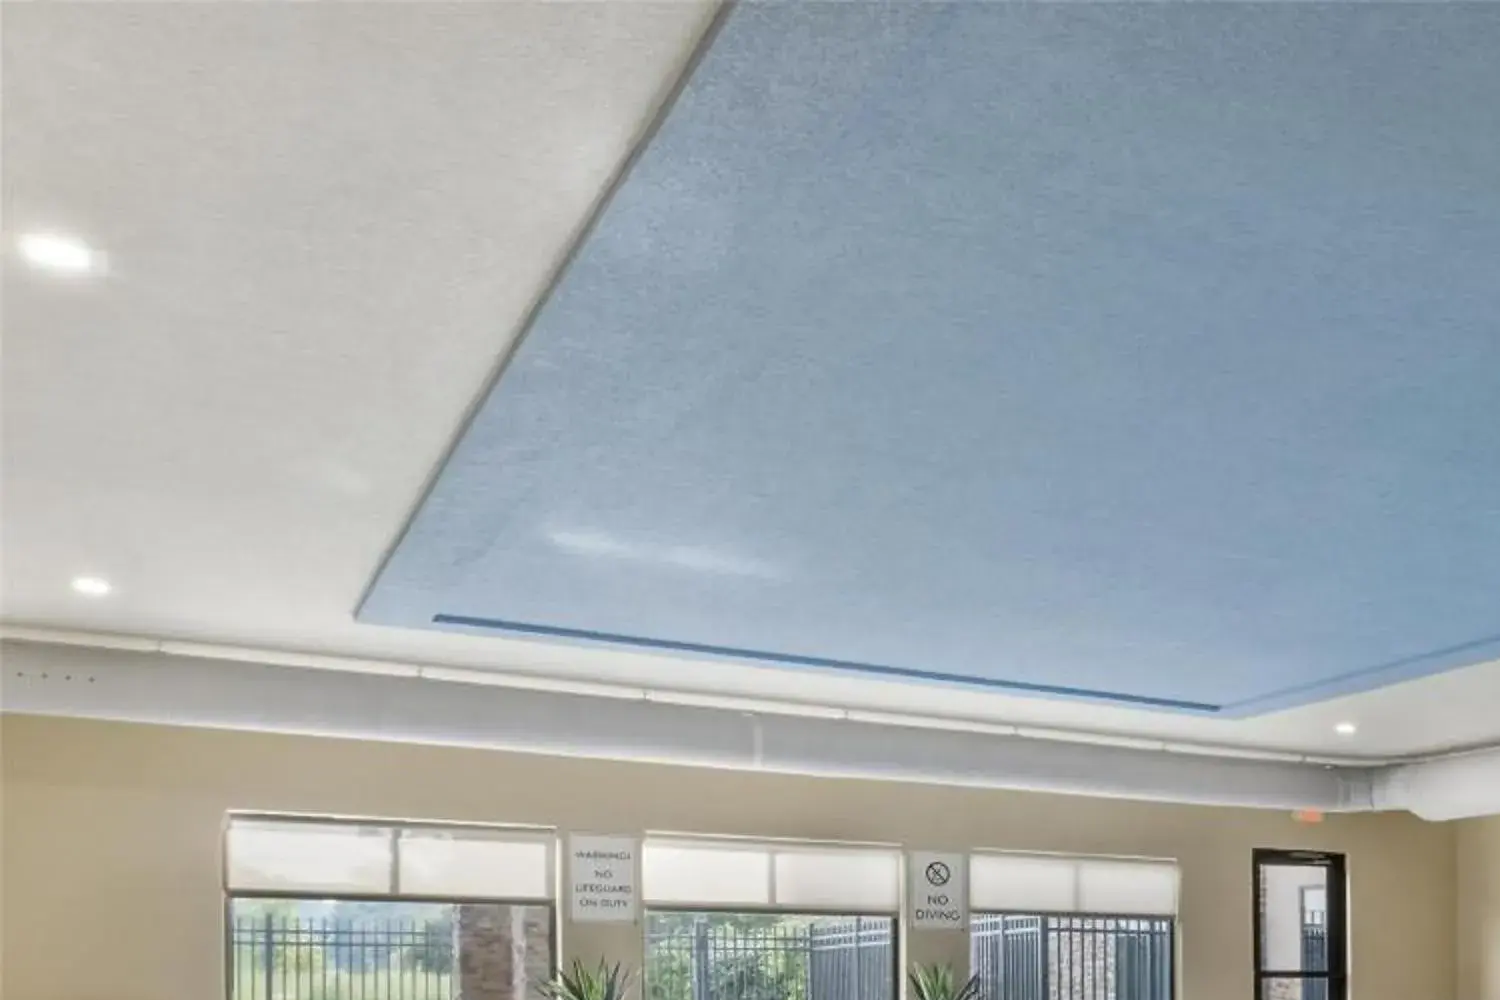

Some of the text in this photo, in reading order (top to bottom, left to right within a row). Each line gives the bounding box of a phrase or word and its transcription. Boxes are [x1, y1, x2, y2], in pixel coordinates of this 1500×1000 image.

[594, 869, 613, 879] NO
[927, 895, 949, 906] NO
[915, 909, 961, 921] DIVING
